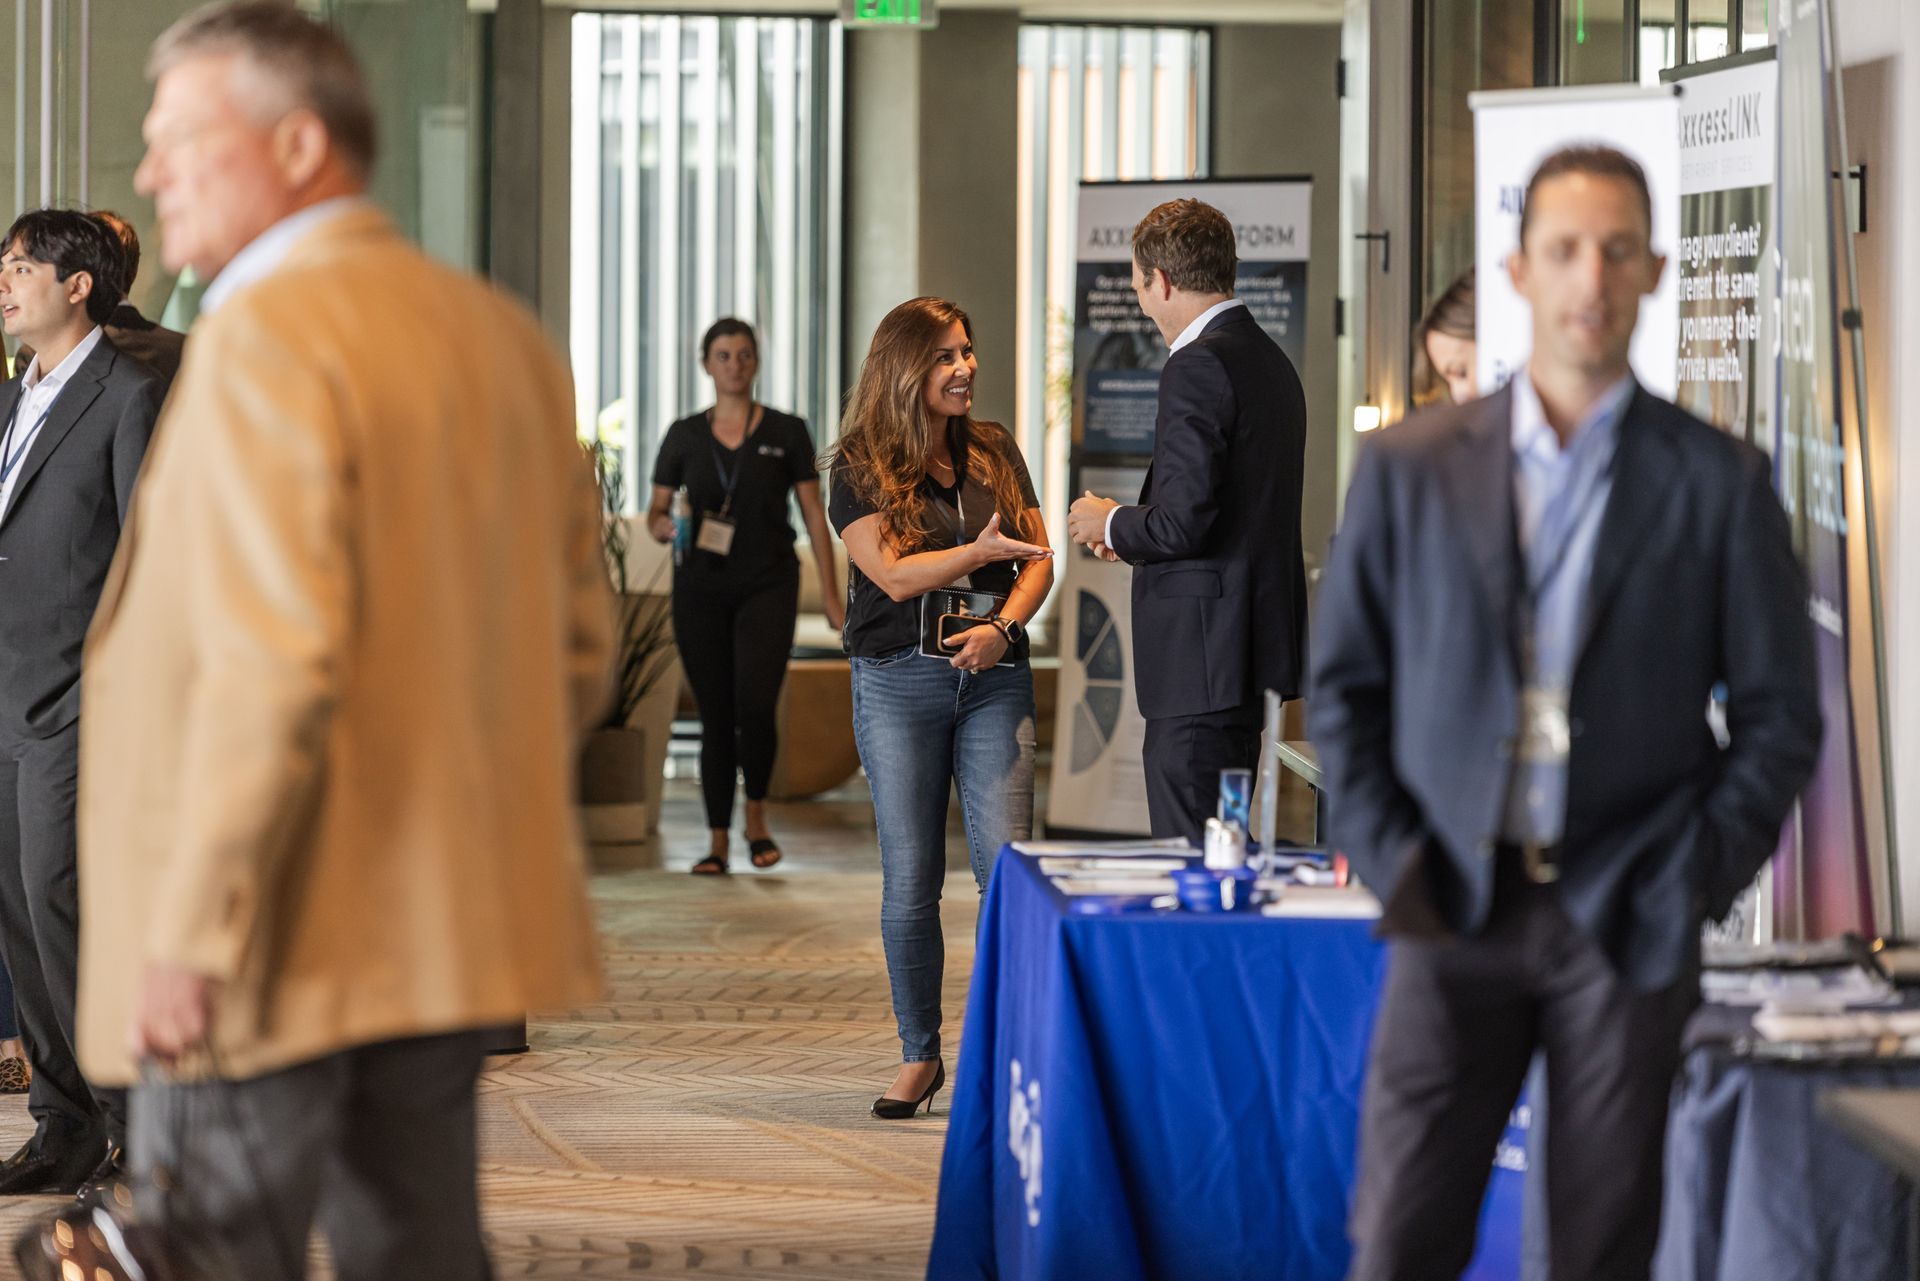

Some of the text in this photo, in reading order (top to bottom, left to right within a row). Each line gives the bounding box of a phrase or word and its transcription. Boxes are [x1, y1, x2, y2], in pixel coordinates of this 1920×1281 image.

[1237, 224, 1295, 247] FORM
[1703, 233, 1724, 267] your
[1715, 266, 1729, 299] the
[1730, 272, 1759, 299] same
[1681, 317, 1698, 348] you
[1699, 315, 1733, 348] manage
[1735, 304, 1761, 340] their
[1707, 348, 1742, 381] wealth.
